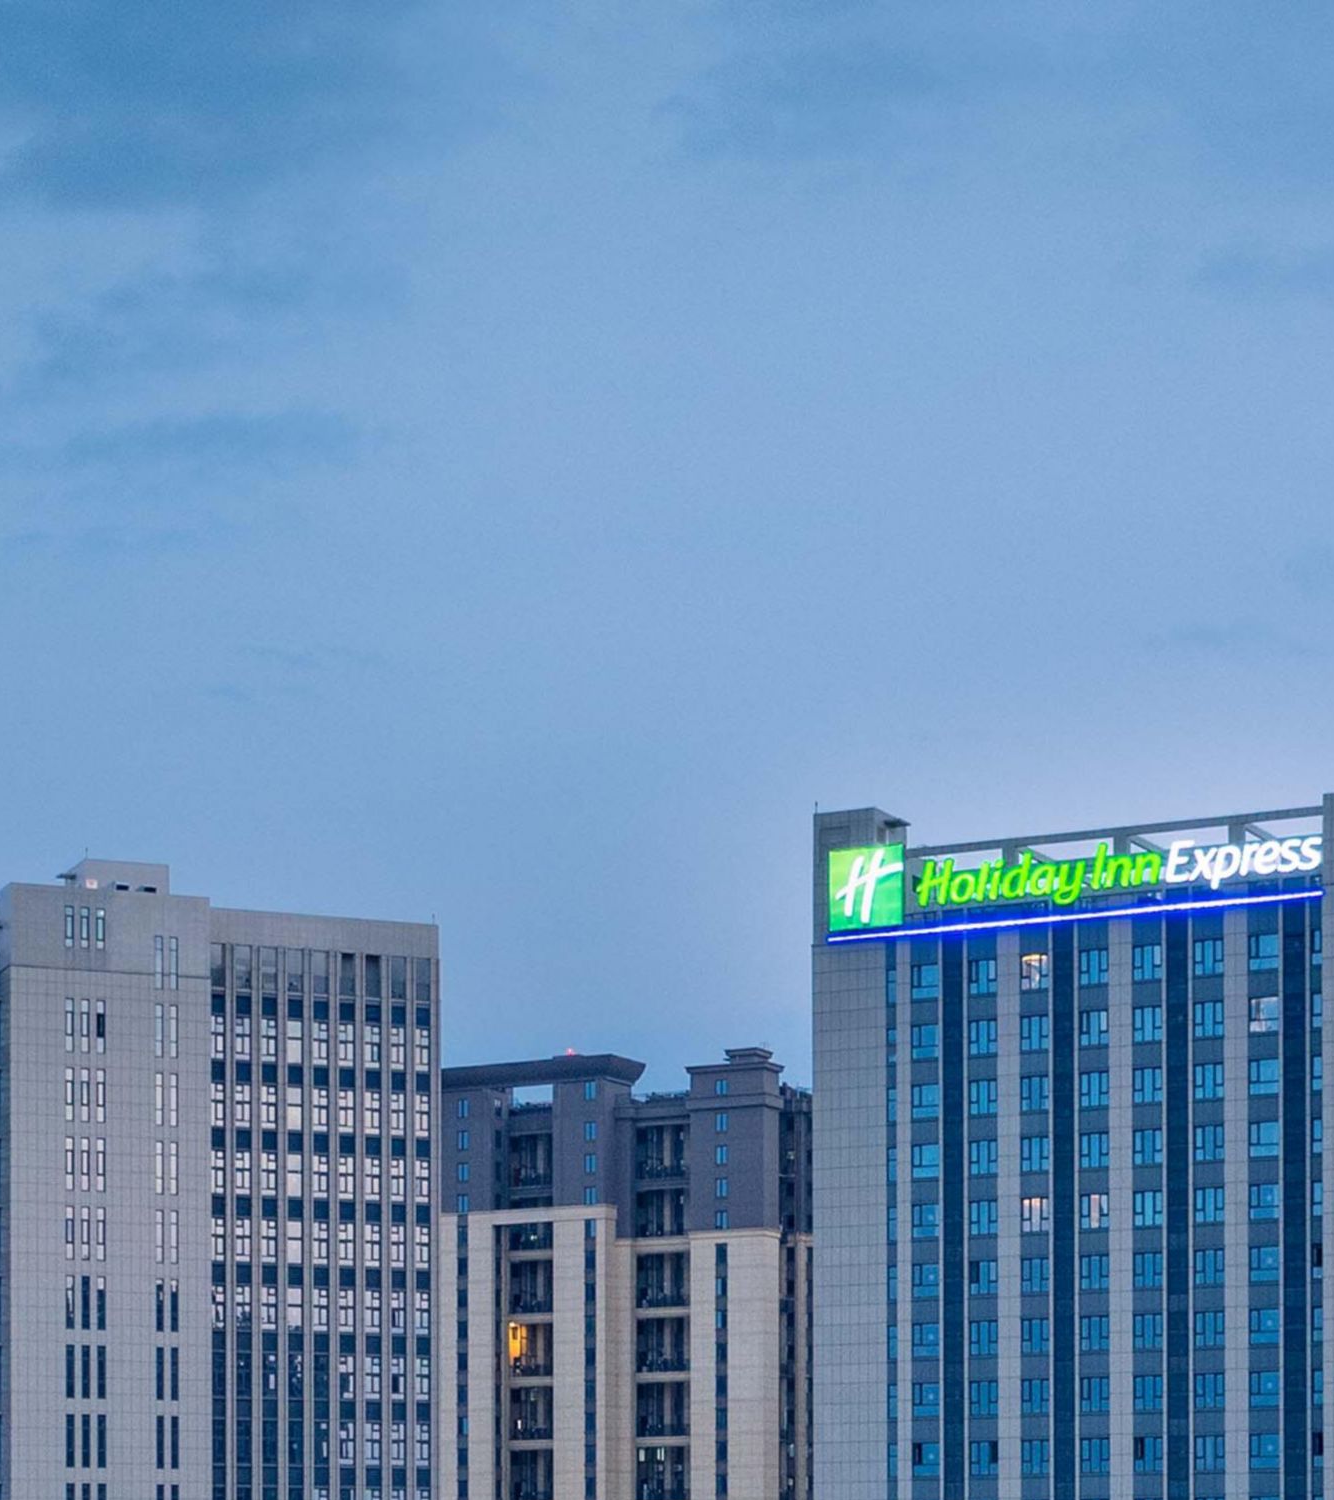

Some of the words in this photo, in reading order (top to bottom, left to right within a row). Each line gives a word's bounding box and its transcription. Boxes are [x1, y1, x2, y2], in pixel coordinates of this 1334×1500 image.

[916, 851, 1087, 906] Holiday
[1090, 842, 1162, 890] Inn
[1165, 836, 1323, 890] Express
